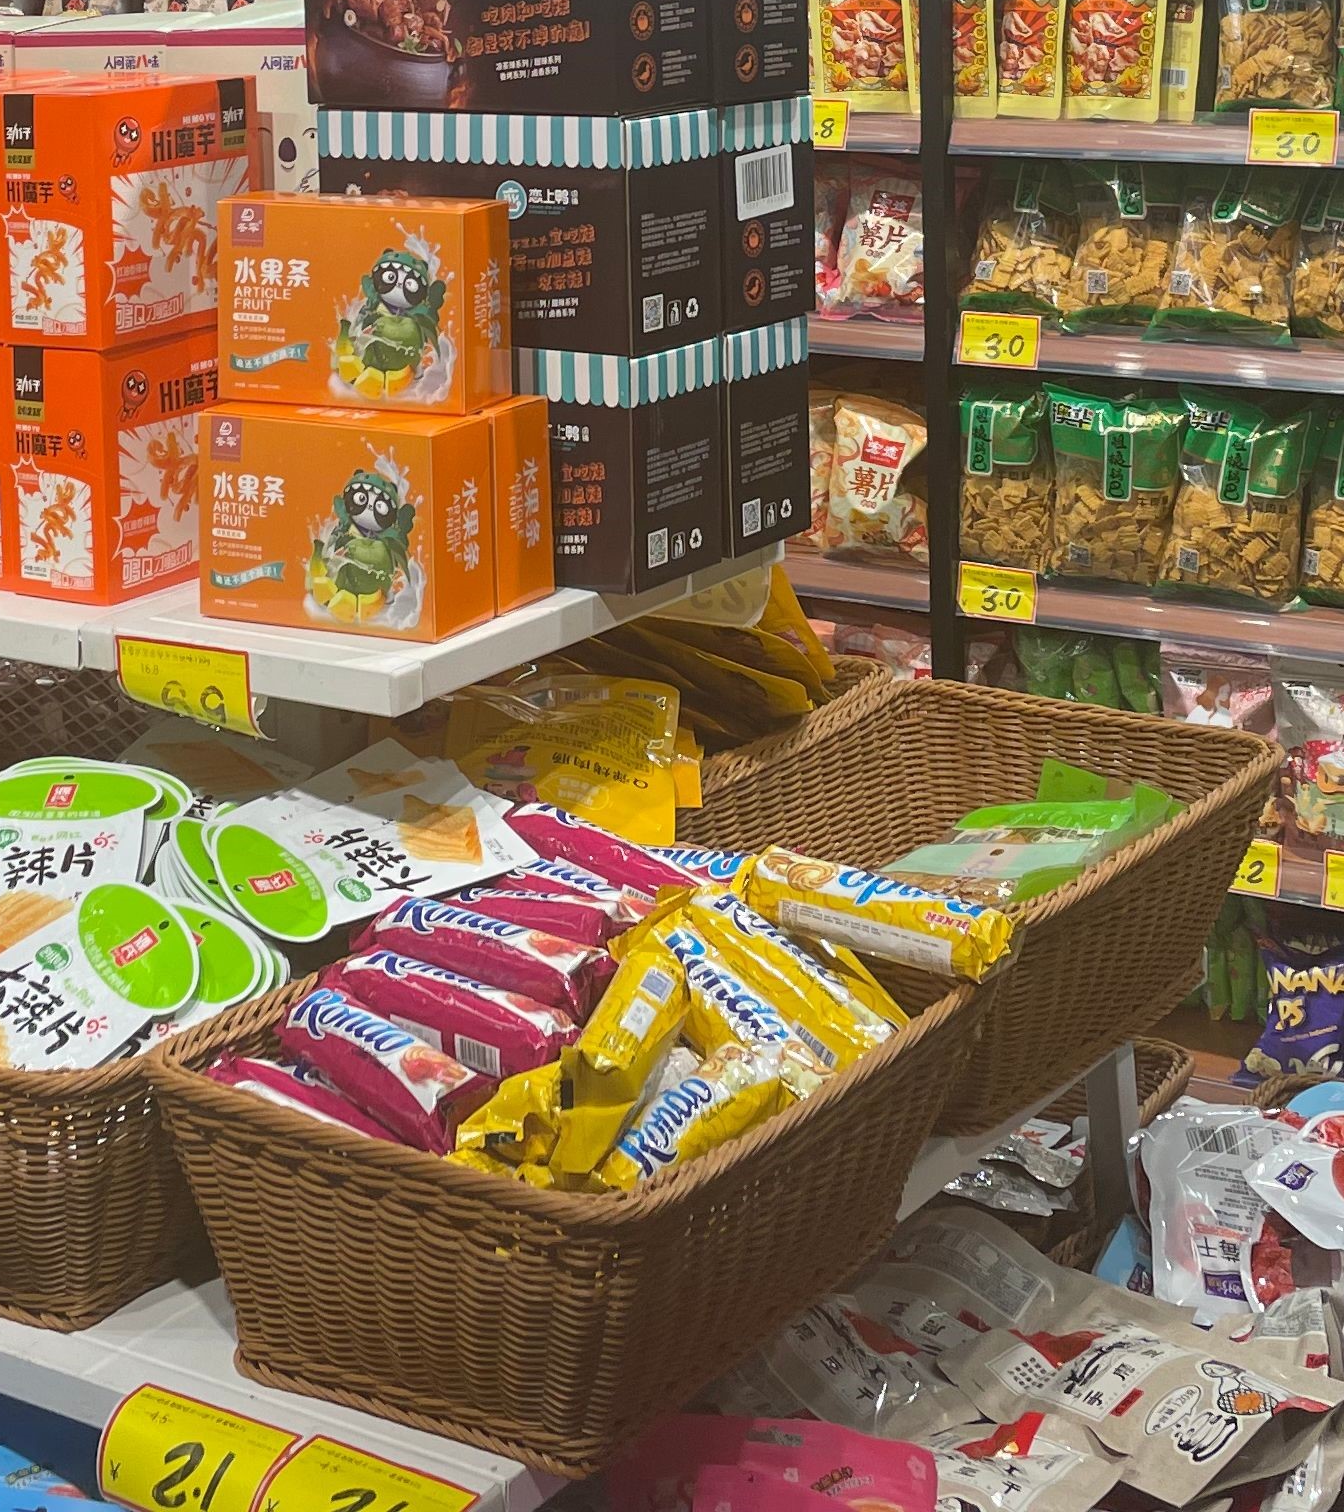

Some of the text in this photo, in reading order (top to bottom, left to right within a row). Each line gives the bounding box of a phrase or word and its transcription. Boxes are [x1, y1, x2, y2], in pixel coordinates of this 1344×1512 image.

[1276, 131, 1321, 159] 3.0
[858, 222, 909, 254] 薯片
[233, 256, 311, 288] 水果条
[233, 286, 292, 301] ARTICLE
[233, 298, 273, 312] FRUIT
[985, 333, 1025, 360] 3.0
[212, 472, 286, 506] 水果条
[848, 466, 896, 502] 薯片
[212, 500, 269, 519] ARTICLE
[212, 512, 250, 529] FRUIT
[980, 586, 1022, 613] 3.0
[323, 825, 434, 894] 大辣片
